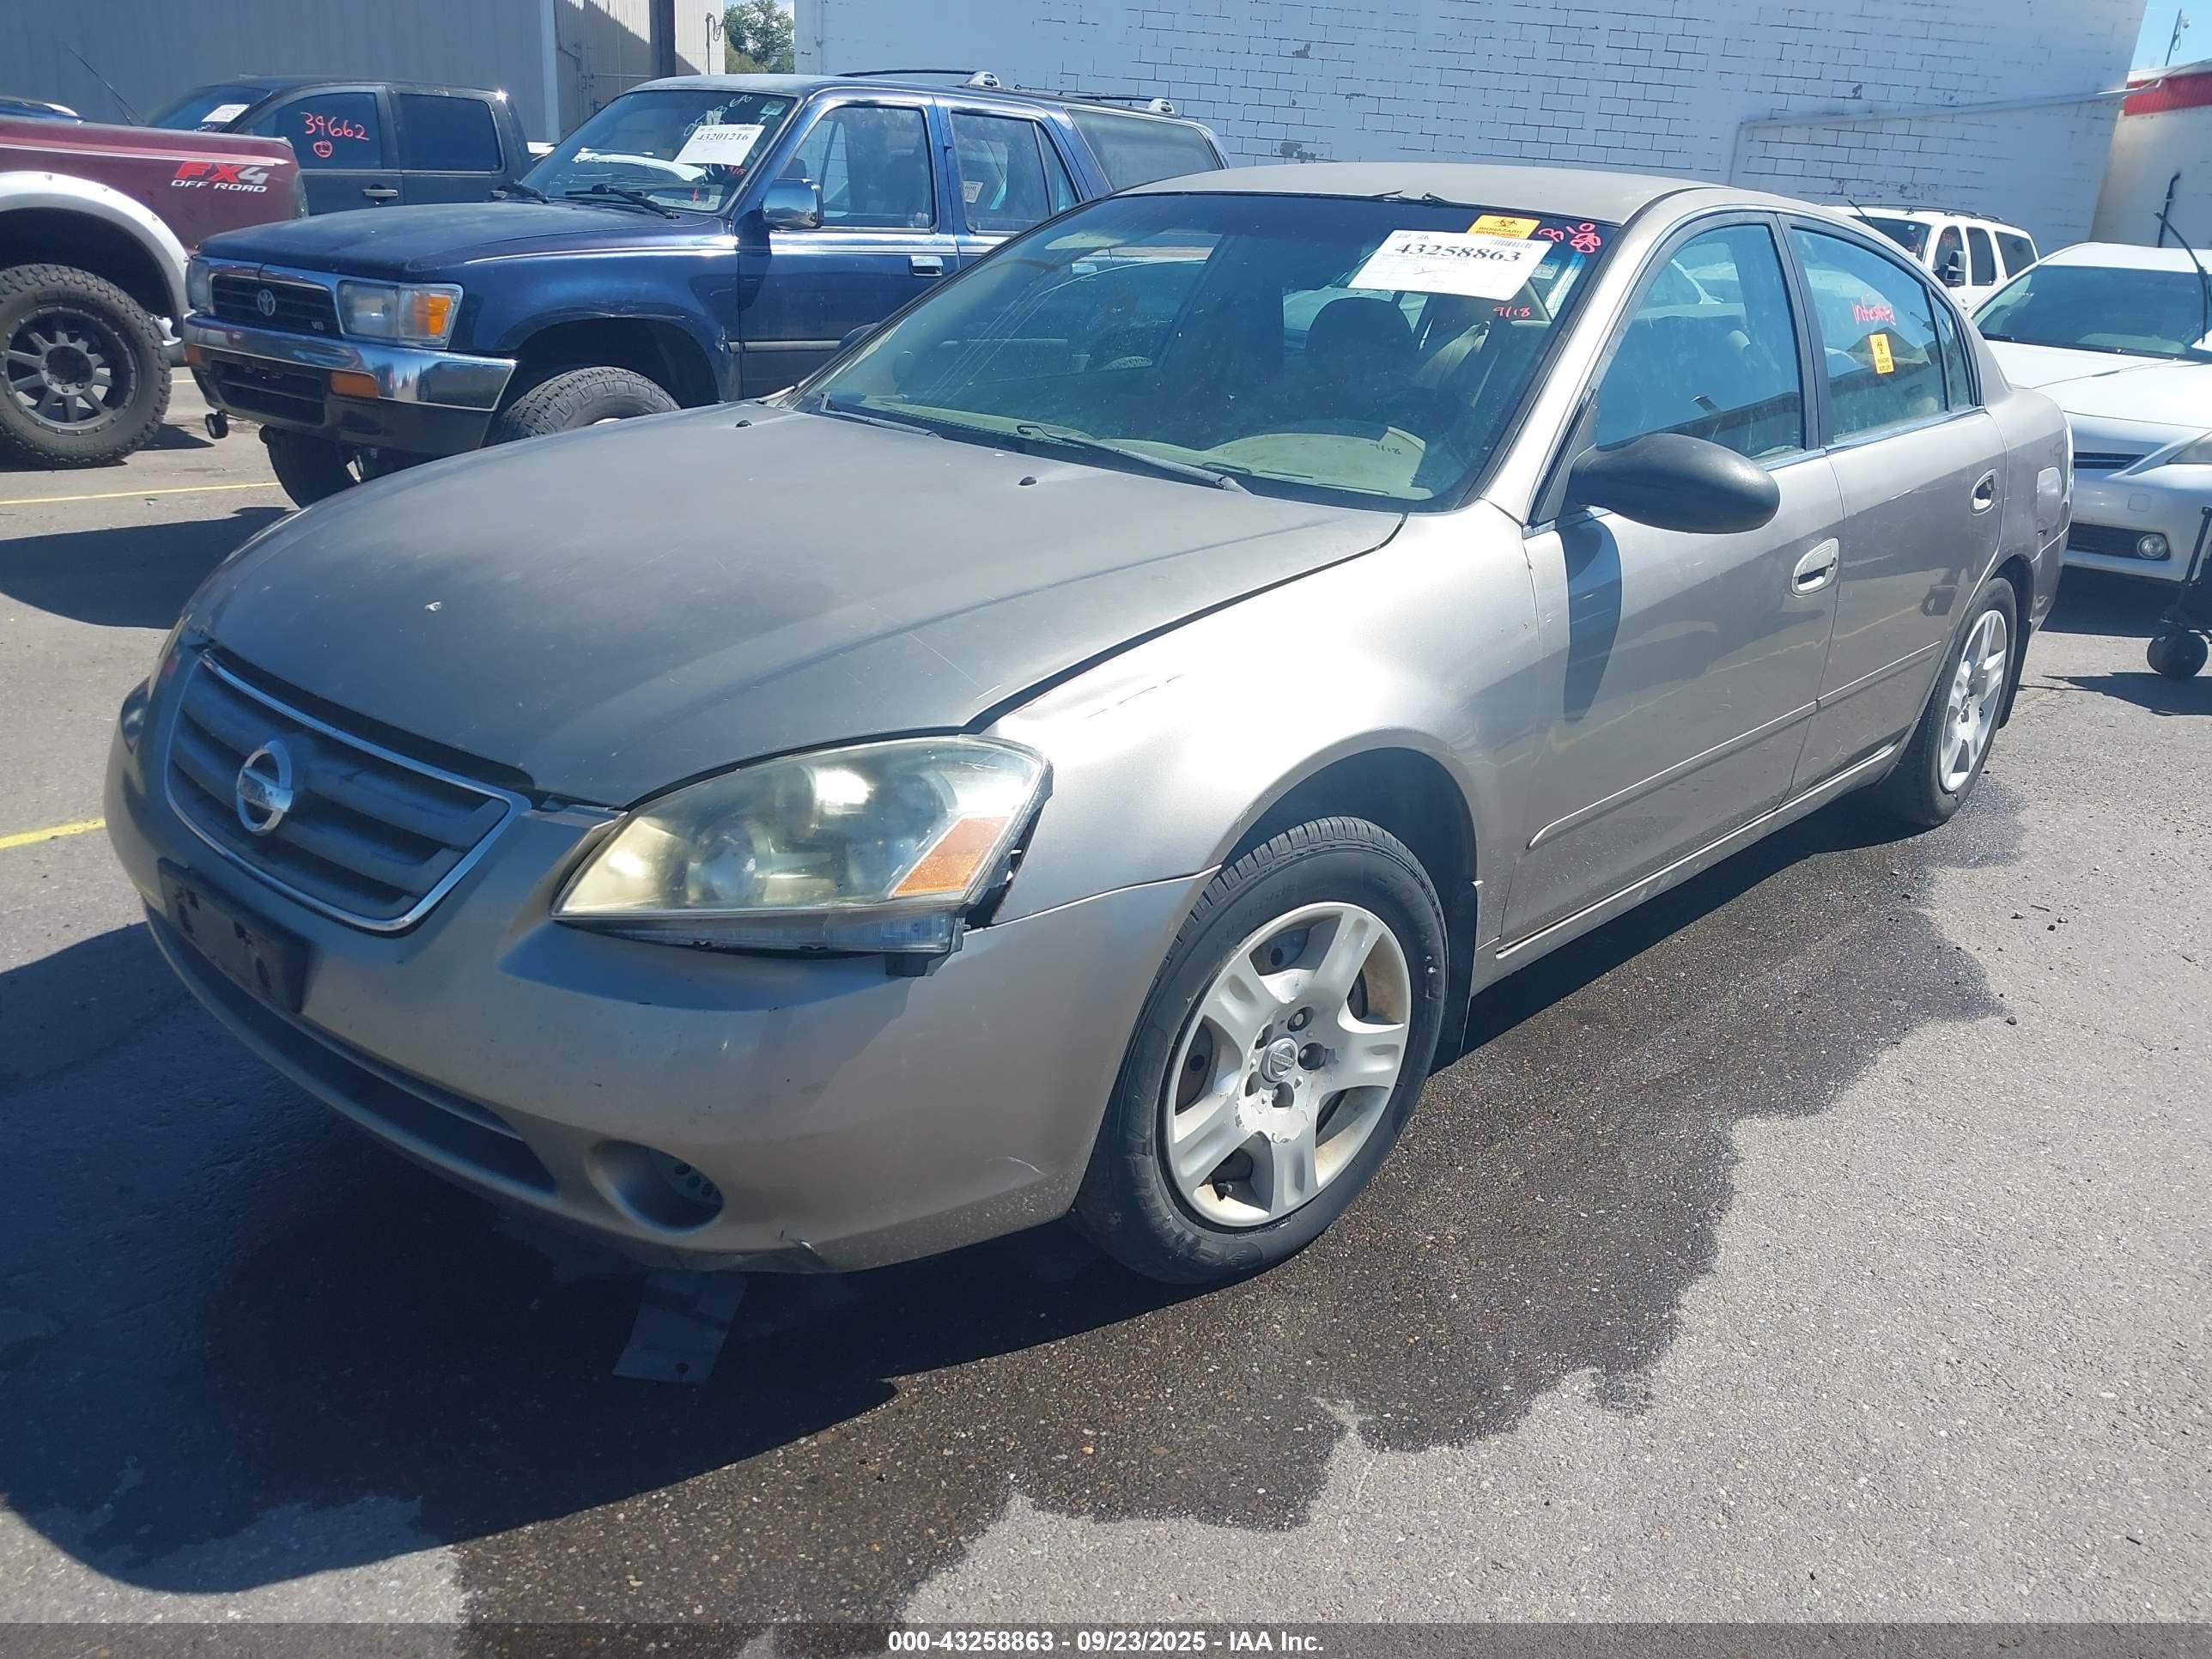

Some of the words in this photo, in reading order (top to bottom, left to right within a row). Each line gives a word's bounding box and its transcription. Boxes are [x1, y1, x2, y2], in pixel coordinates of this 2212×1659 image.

[173, 161, 270, 185] FX4
[171, 179, 209, 190] OFF
[214, 182, 268, 193] ROAD
[1395, 243, 1522, 262] 43258863
[1492, 305, 1531, 318] 9/18
